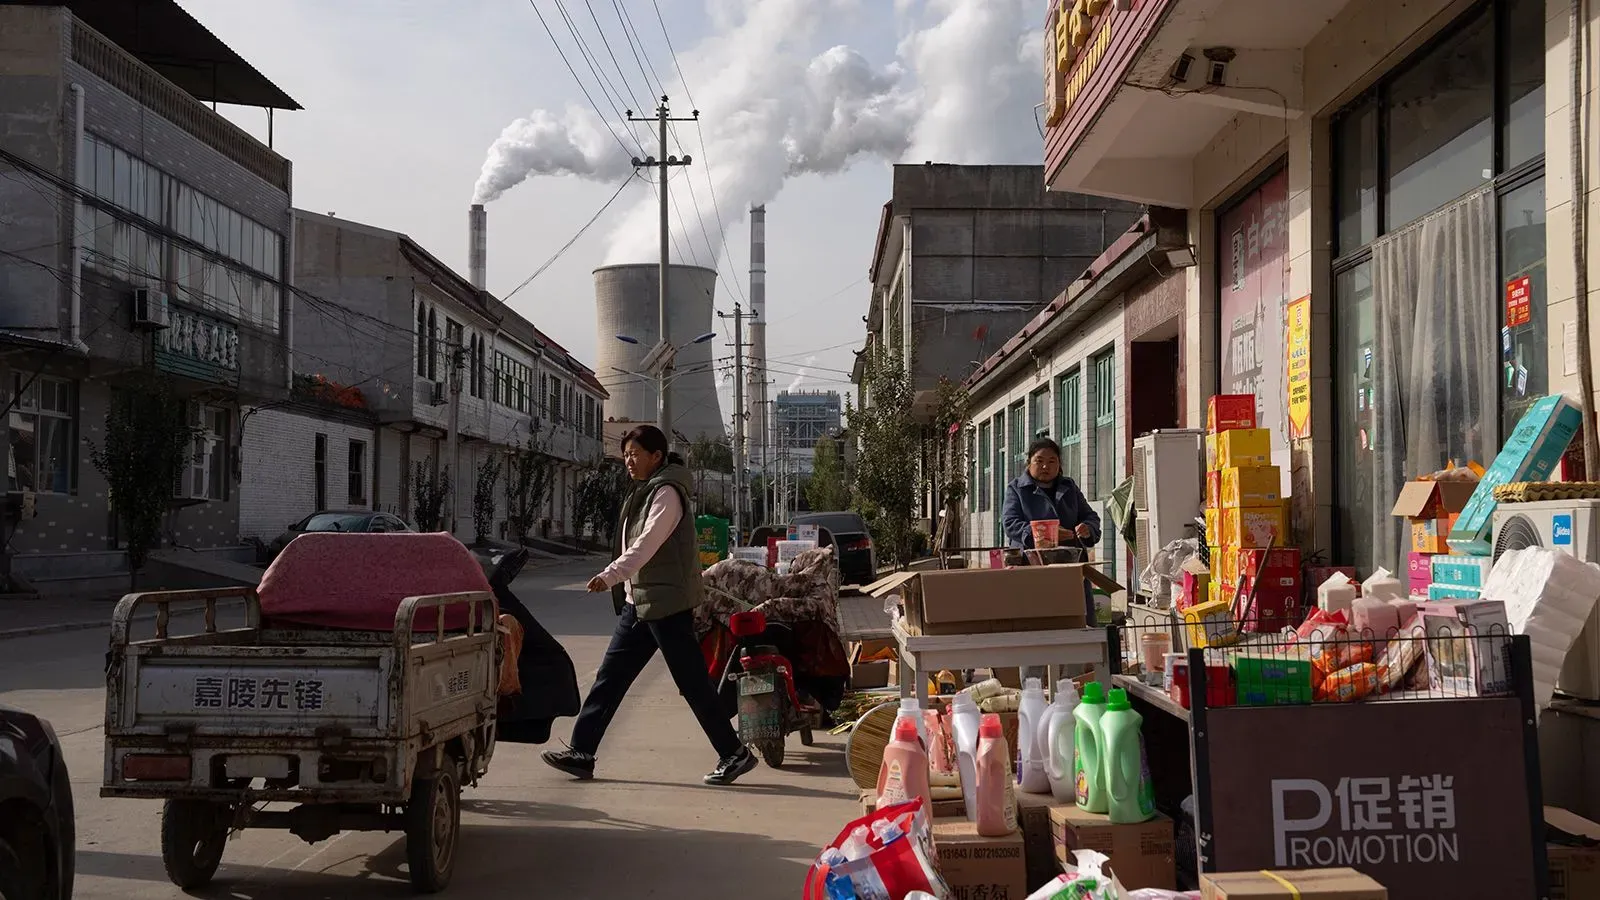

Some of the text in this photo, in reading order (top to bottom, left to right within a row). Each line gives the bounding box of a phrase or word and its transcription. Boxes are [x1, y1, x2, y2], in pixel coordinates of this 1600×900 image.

[194, 677, 324, 711] 嘉陵先锋
[1335, 774, 1456, 831] 促销
